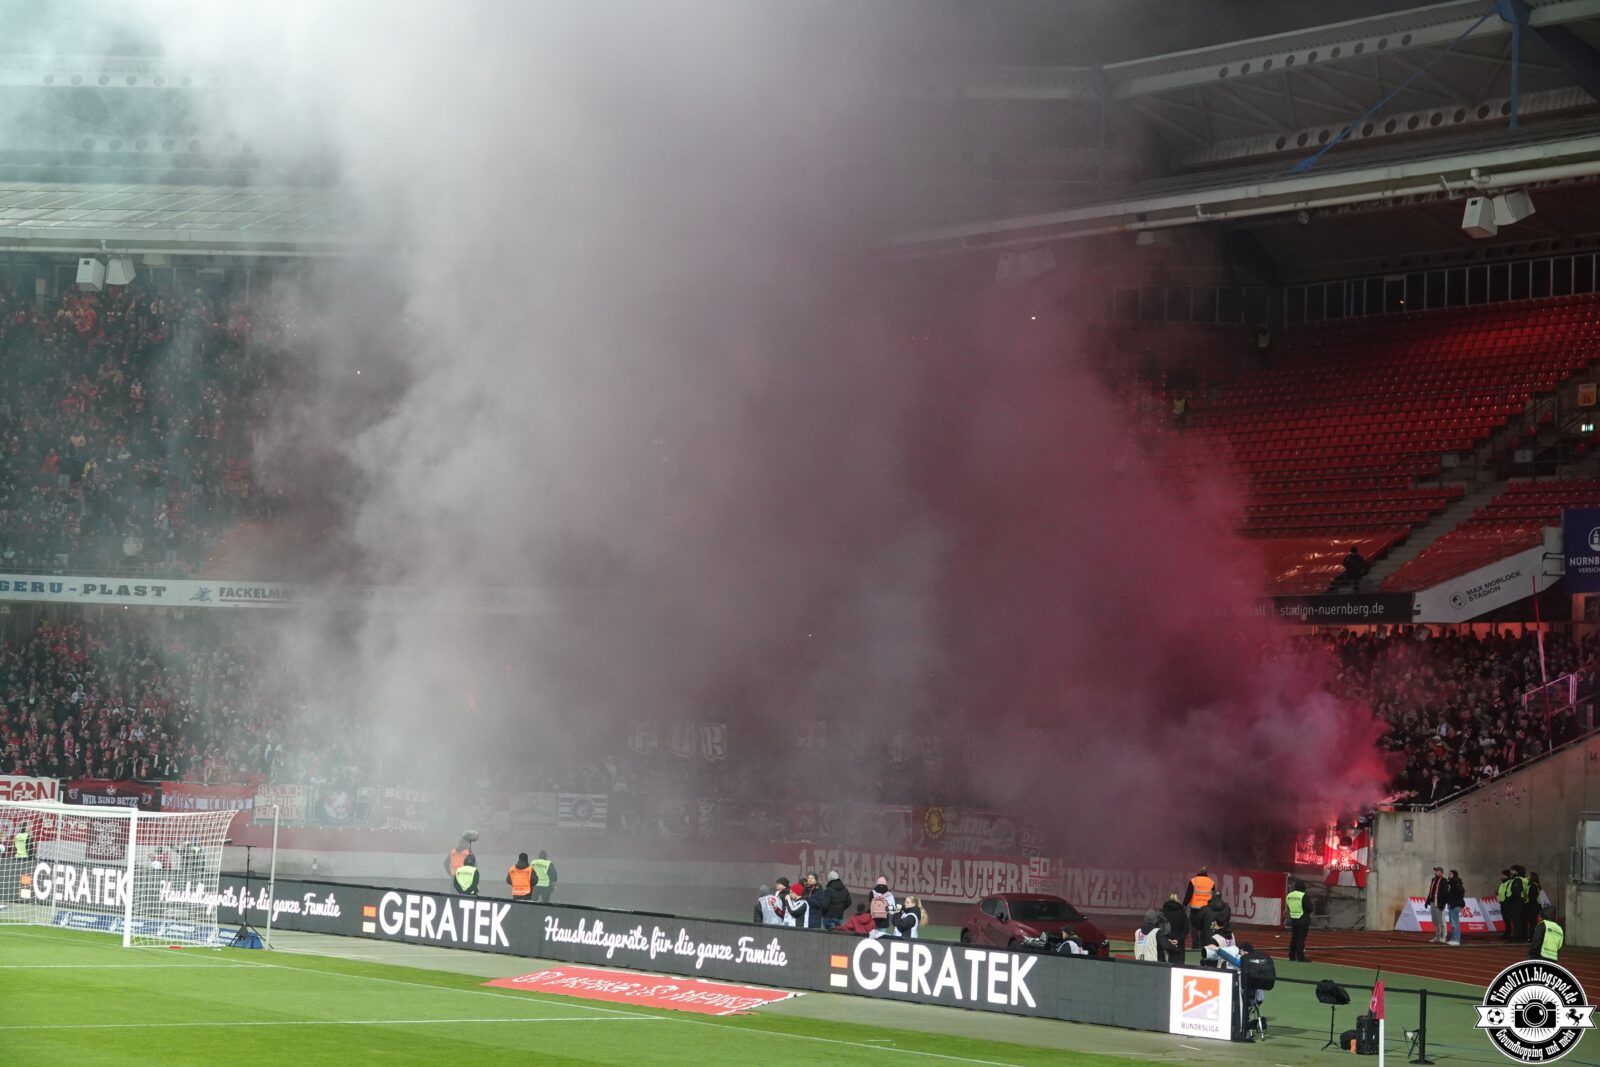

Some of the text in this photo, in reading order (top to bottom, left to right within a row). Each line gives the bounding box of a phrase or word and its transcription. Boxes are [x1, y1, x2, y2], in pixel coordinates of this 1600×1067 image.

[1466, 570, 1522, 596] MAX MORLOCK
[1468, 585, 1502, 602] STADION
[1280, 602, 1384, 617] stadion-nuernberg.de
[82, 793, 139, 808] WIR SIND BETZE
[33, 862, 131, 908] GERATEK
[160, 879, 239, 915] Haushaltsgeräte
[273, 899, 301, 922] ganze
[302, 892, 342, 918] Familie
[379, 891, 512, 947] GERATEK
[545, 915, 788, 970] Haushaltsgeräte für die ganze Familie
[853, 938, 1038, 1008] GERATEK
[1181, 1022, 1219, 1032] BUNDESLIGA
